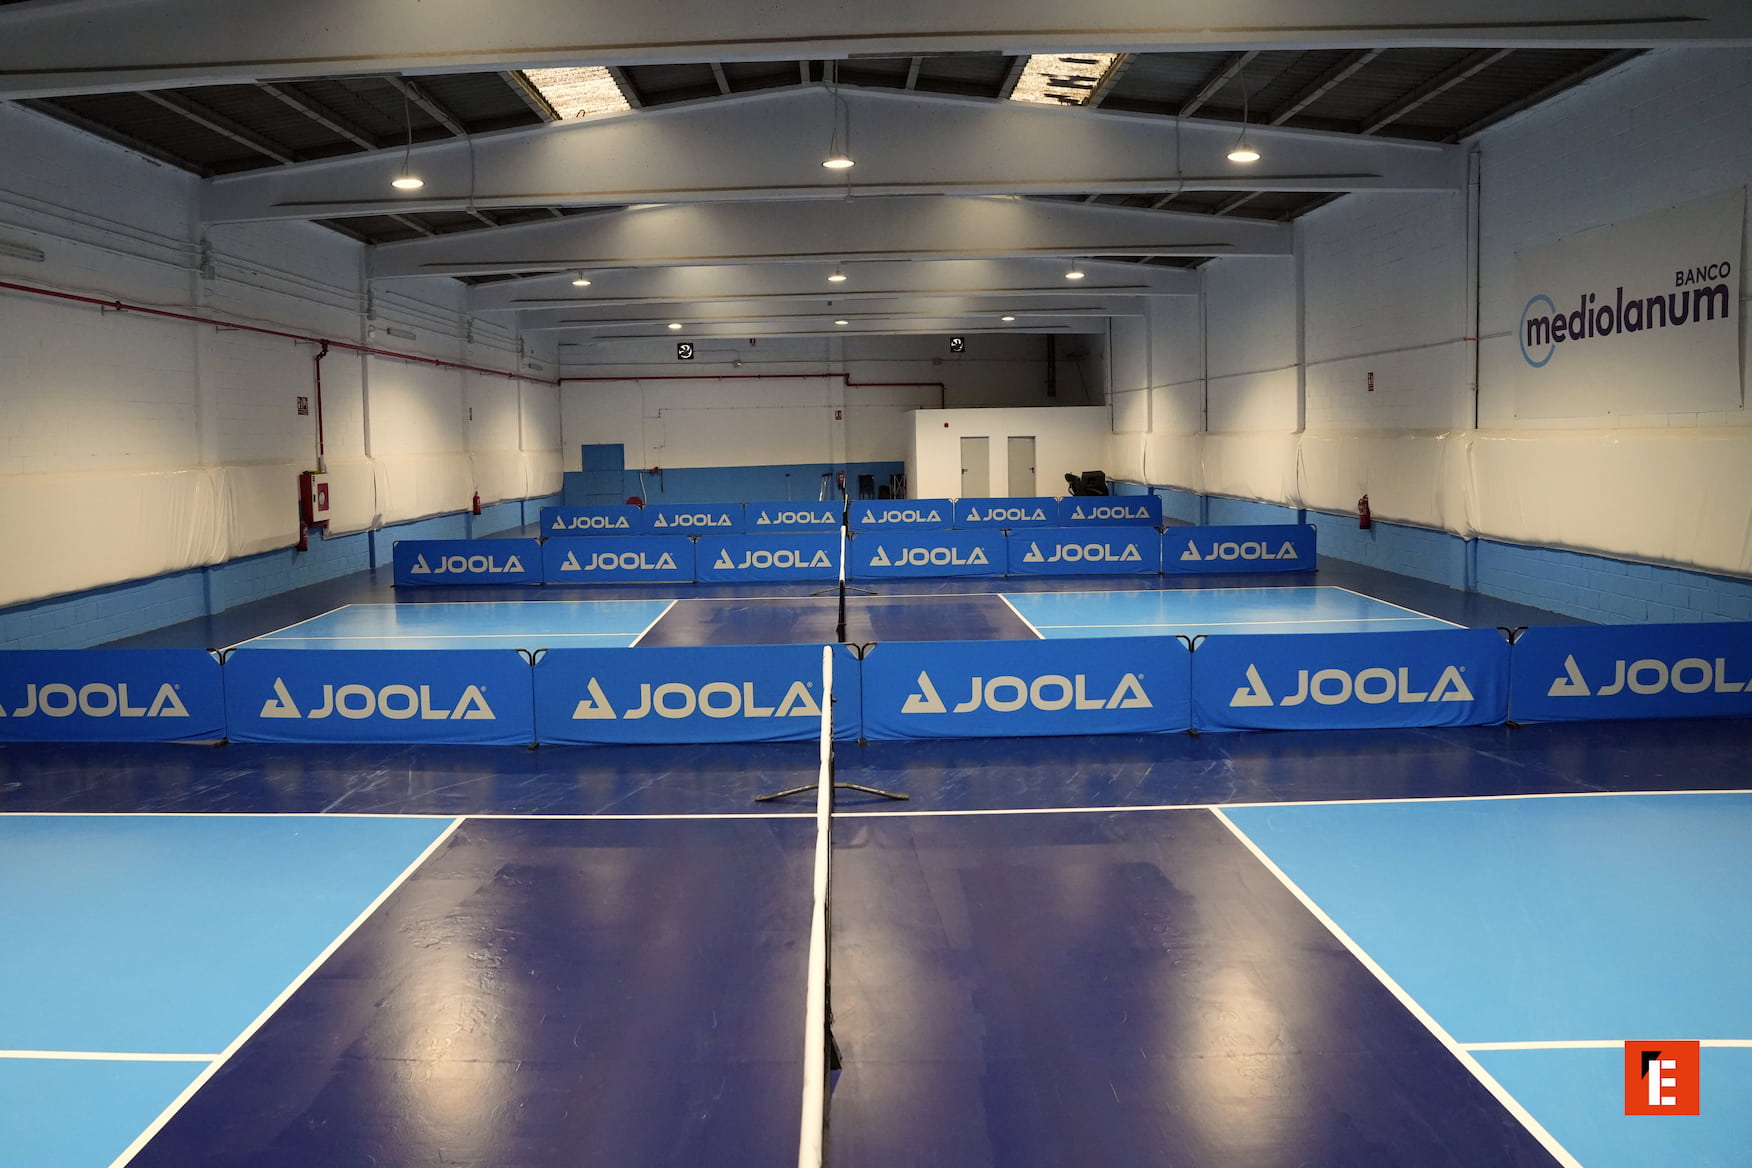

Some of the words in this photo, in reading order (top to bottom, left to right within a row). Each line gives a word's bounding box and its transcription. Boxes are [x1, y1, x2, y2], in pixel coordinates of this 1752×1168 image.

[1675, 261, 1731, 287] BANCO
[1527, 283, 1729, 347] mediolanum
[568, 516, 630, 529] JOOLA
[669, 513, 732, 527] JOOLA
[772, 511, 836, 525] JOOLA
[877, 510, 942, 523] JOOLA
[982, 508, 1046, 521] JOOLA
[1087, 507, 1150, 519] JOOLA
[737, 549, 832, 569] JOOLA
[894, 547, 989, 566] JOOLA
[1047, 543, 1142, 562] JOOLA
[1204, 541, 1297, 560] JOOLA
[434, 555, 525, 574] JOOLA
[584, 552, 677, 571] JOOLA
[1279, 665, 1474, 706] JOOLA
[1597, 657, 1752, 696] JOOL
[13, 683, 190, 717] JOOLA
[307, 684, 497, 720] JOOLA
[623, 680, 822, 719] JOOLA
[953, 672, 1153, 713] JOOLA
